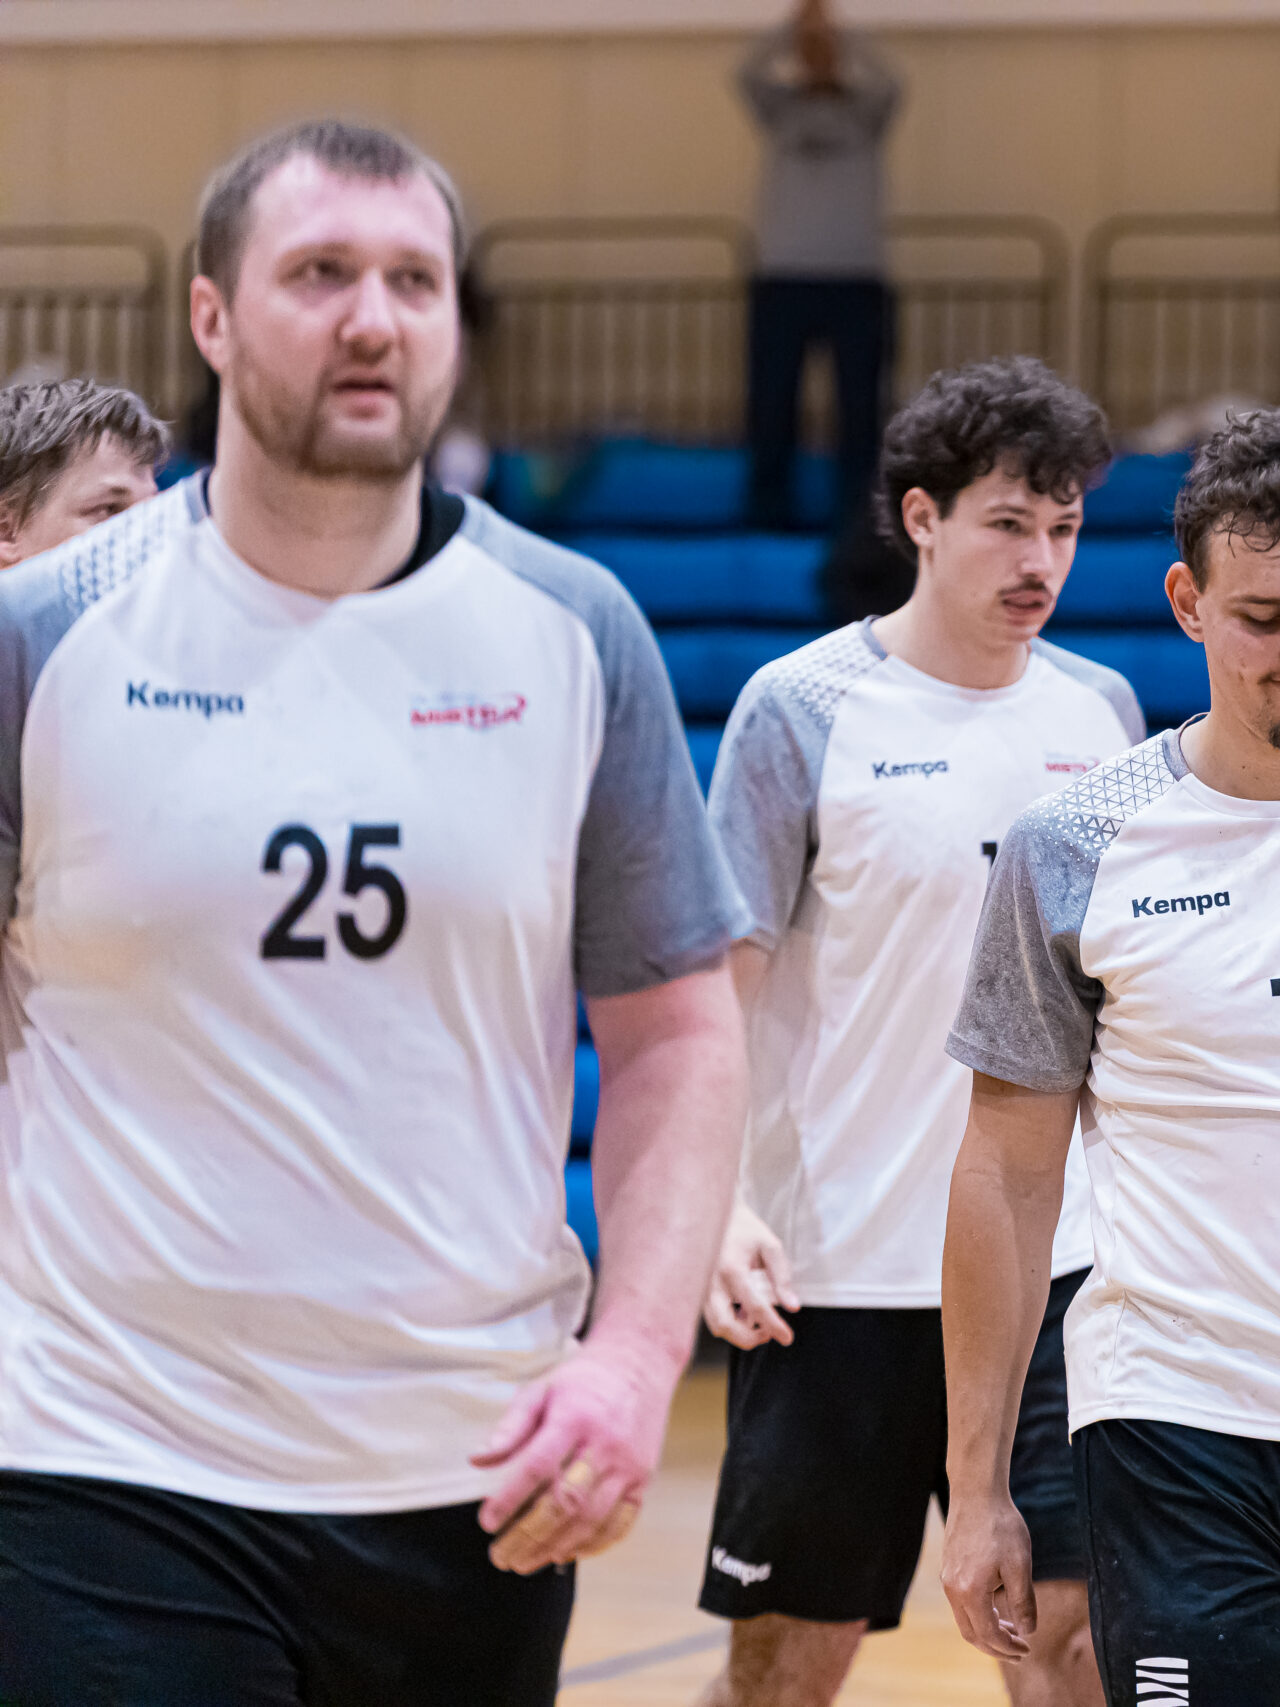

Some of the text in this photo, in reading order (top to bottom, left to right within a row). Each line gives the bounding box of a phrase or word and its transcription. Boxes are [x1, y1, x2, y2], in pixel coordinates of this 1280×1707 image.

[126, 681, 244, 718] Kempa
[872, 760, 948, 779] Kempa
[260, 822, 408, 960] 25
[1131, 891, 1231, 918] Kempa
[711, 1546, 773, 1587] Kempa
